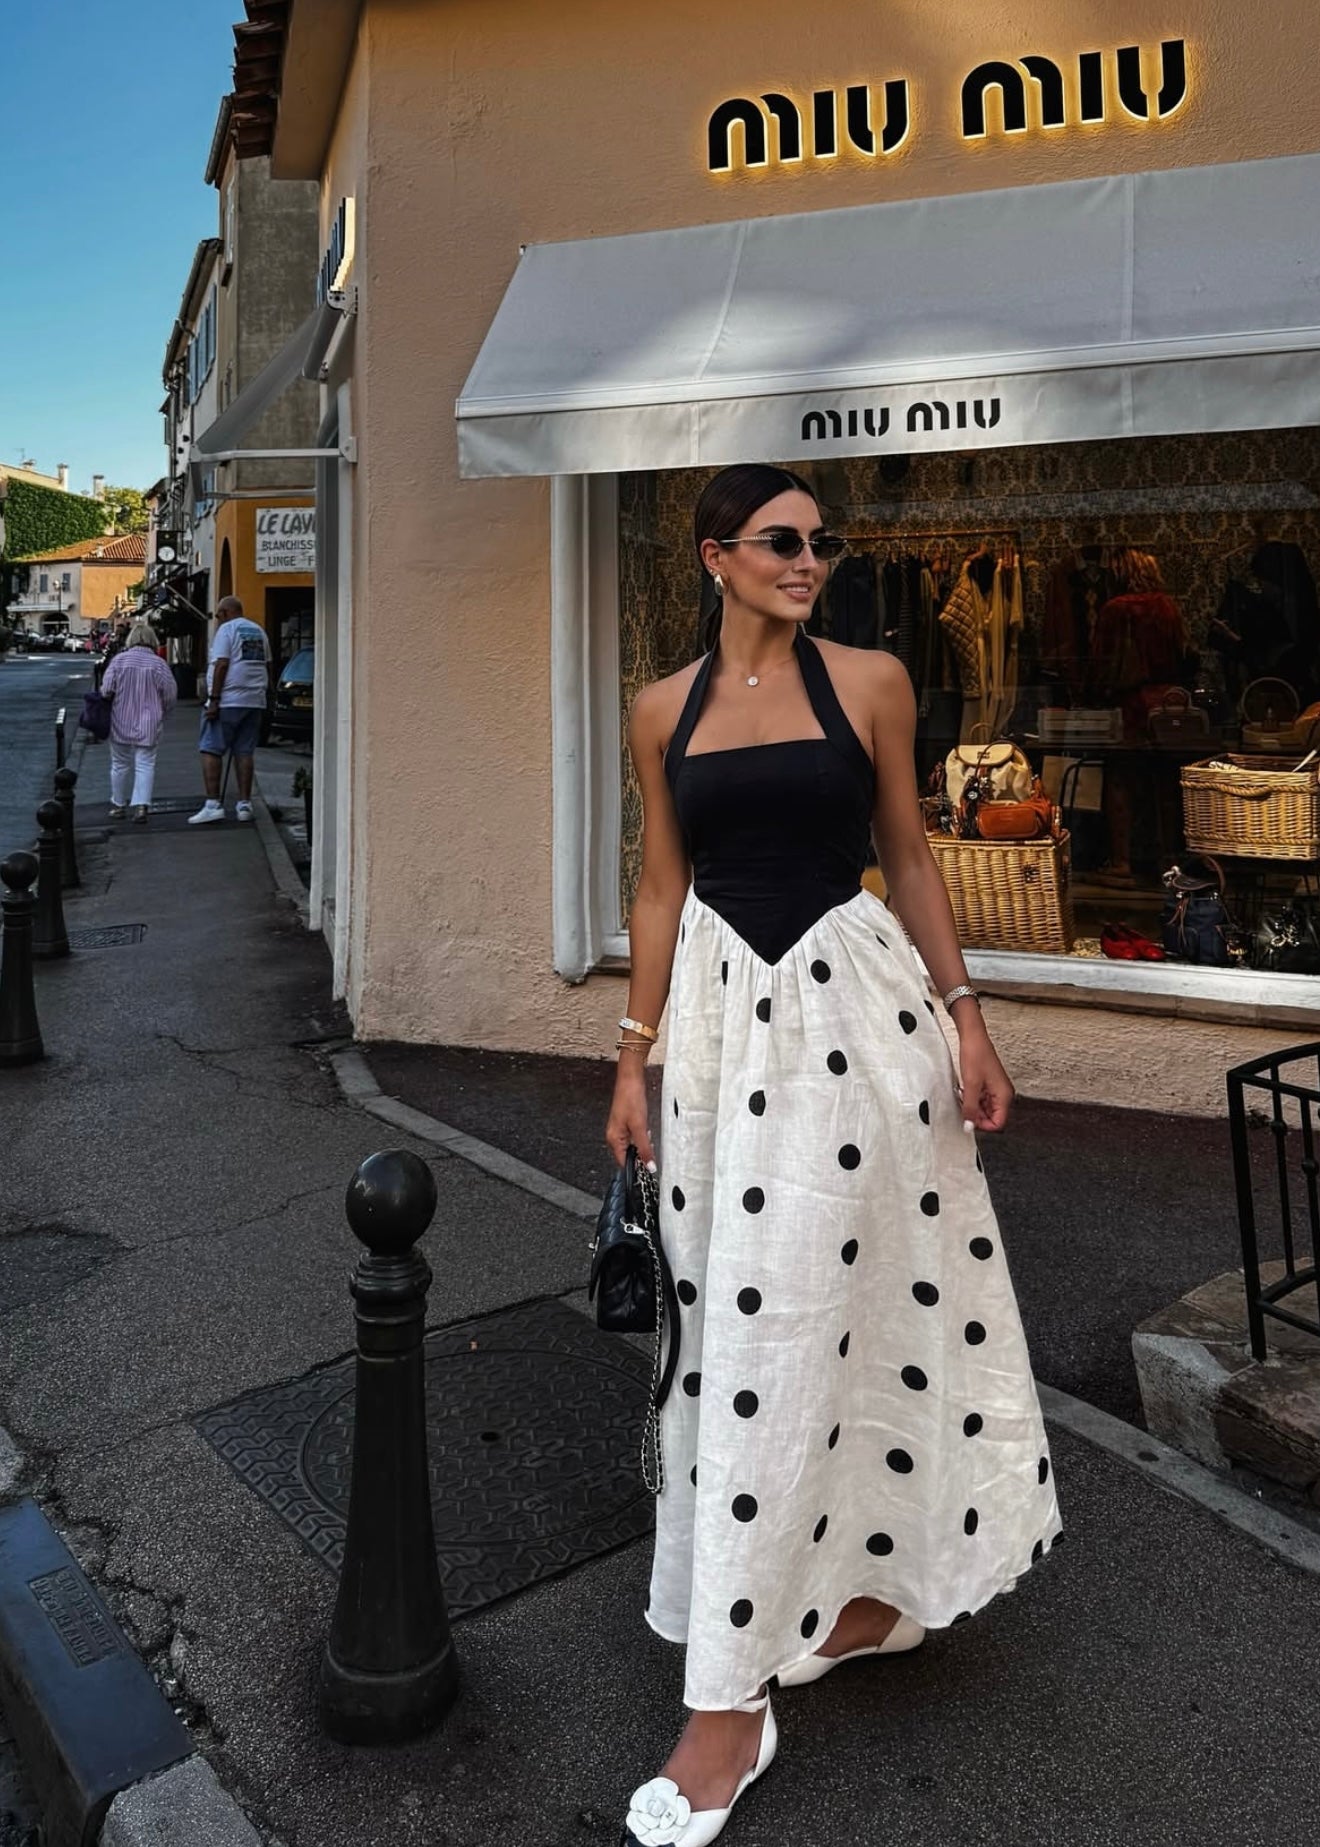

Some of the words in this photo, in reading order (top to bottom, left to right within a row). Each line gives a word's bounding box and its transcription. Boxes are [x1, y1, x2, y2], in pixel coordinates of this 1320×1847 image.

[708, 79, 908, 171] MIU
[961, 39, 1186, 138] MIU
[801, 407, 890, 441] MIU
[906, 398, 1001, 432] MIU
[257, 513, 279, 535] LE
[267, 555, 297, 567] LINGE
